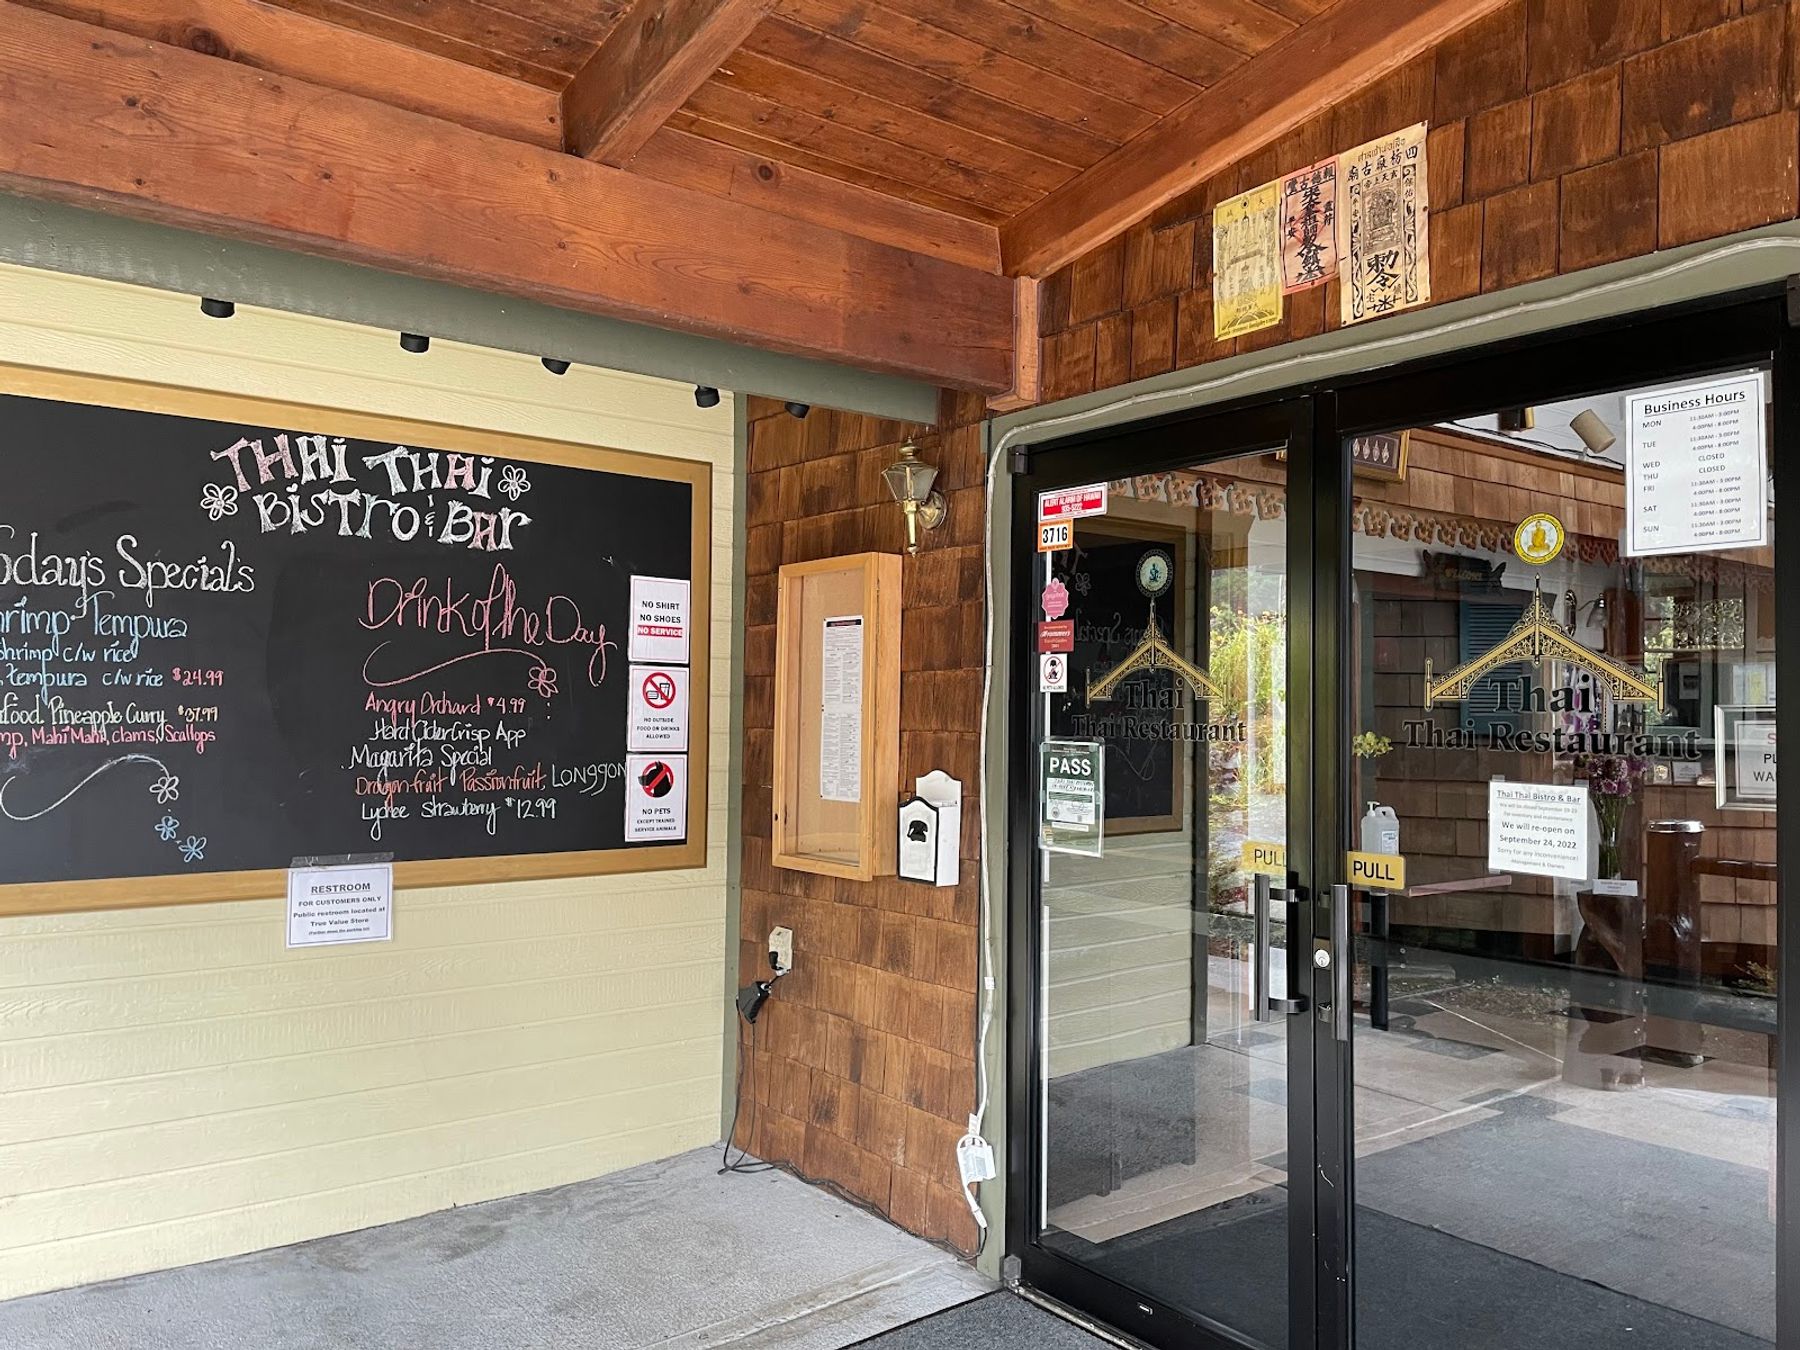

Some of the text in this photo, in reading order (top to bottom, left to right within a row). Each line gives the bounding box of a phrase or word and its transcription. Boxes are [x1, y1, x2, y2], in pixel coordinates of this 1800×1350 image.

[1644, 391, 1746, 415] Business Hours
[1642, 420, 1662, 428] MON
[1698, 452, 1725, 462] CLOSED
[1642, 461, 1661, 469] WED
[1698, 464, 1726, 473] CLOSED
[1643, 473, 1659, 481] THU
[1643, 504, 1657, 513] SAT
[1042, 526, 1068, 544] 3716
[0, 525, 105, 620] oday's
[642, 600, 680, 610] NO SHIRT
[640, 614, 681, 623] NO SHOES
[638, 626, 682, 636] NO SERVICE
[0, 637, 53, 672] hrimp
[1124, 677, 1185, 710] Thai
[1487, 673, 1596, 714] Thai
[365, 691, 416, 728] Angry
[1071, 713, 1248, 742] Thai Restaurant
[496, 720, 526, 749] App
[1402, 718, 1702, 760] Thai Restaurant
[1049, 757, 1092, 776] PASS
[1497, 790, 1513, 798] Thai
[1515, 791, 1531, 799] Thai
[1533, 793, 1556, 801] Bistro
[654, 807, 671, 815] PETS
[1516, 822, 1530, 830] will
[1531, 825, 1563, 834] re-open
[1499, 834, 1577, 849] September 24, 2022
[1497, 847, 1512, 855] Sorry
[1353, 860, 1395, 881] PULL
[310, 882, 371, 894] RESTROOM
[315, 897, 360, 906] CUSTOMERS
[317, 909, 349, 917] restroom
